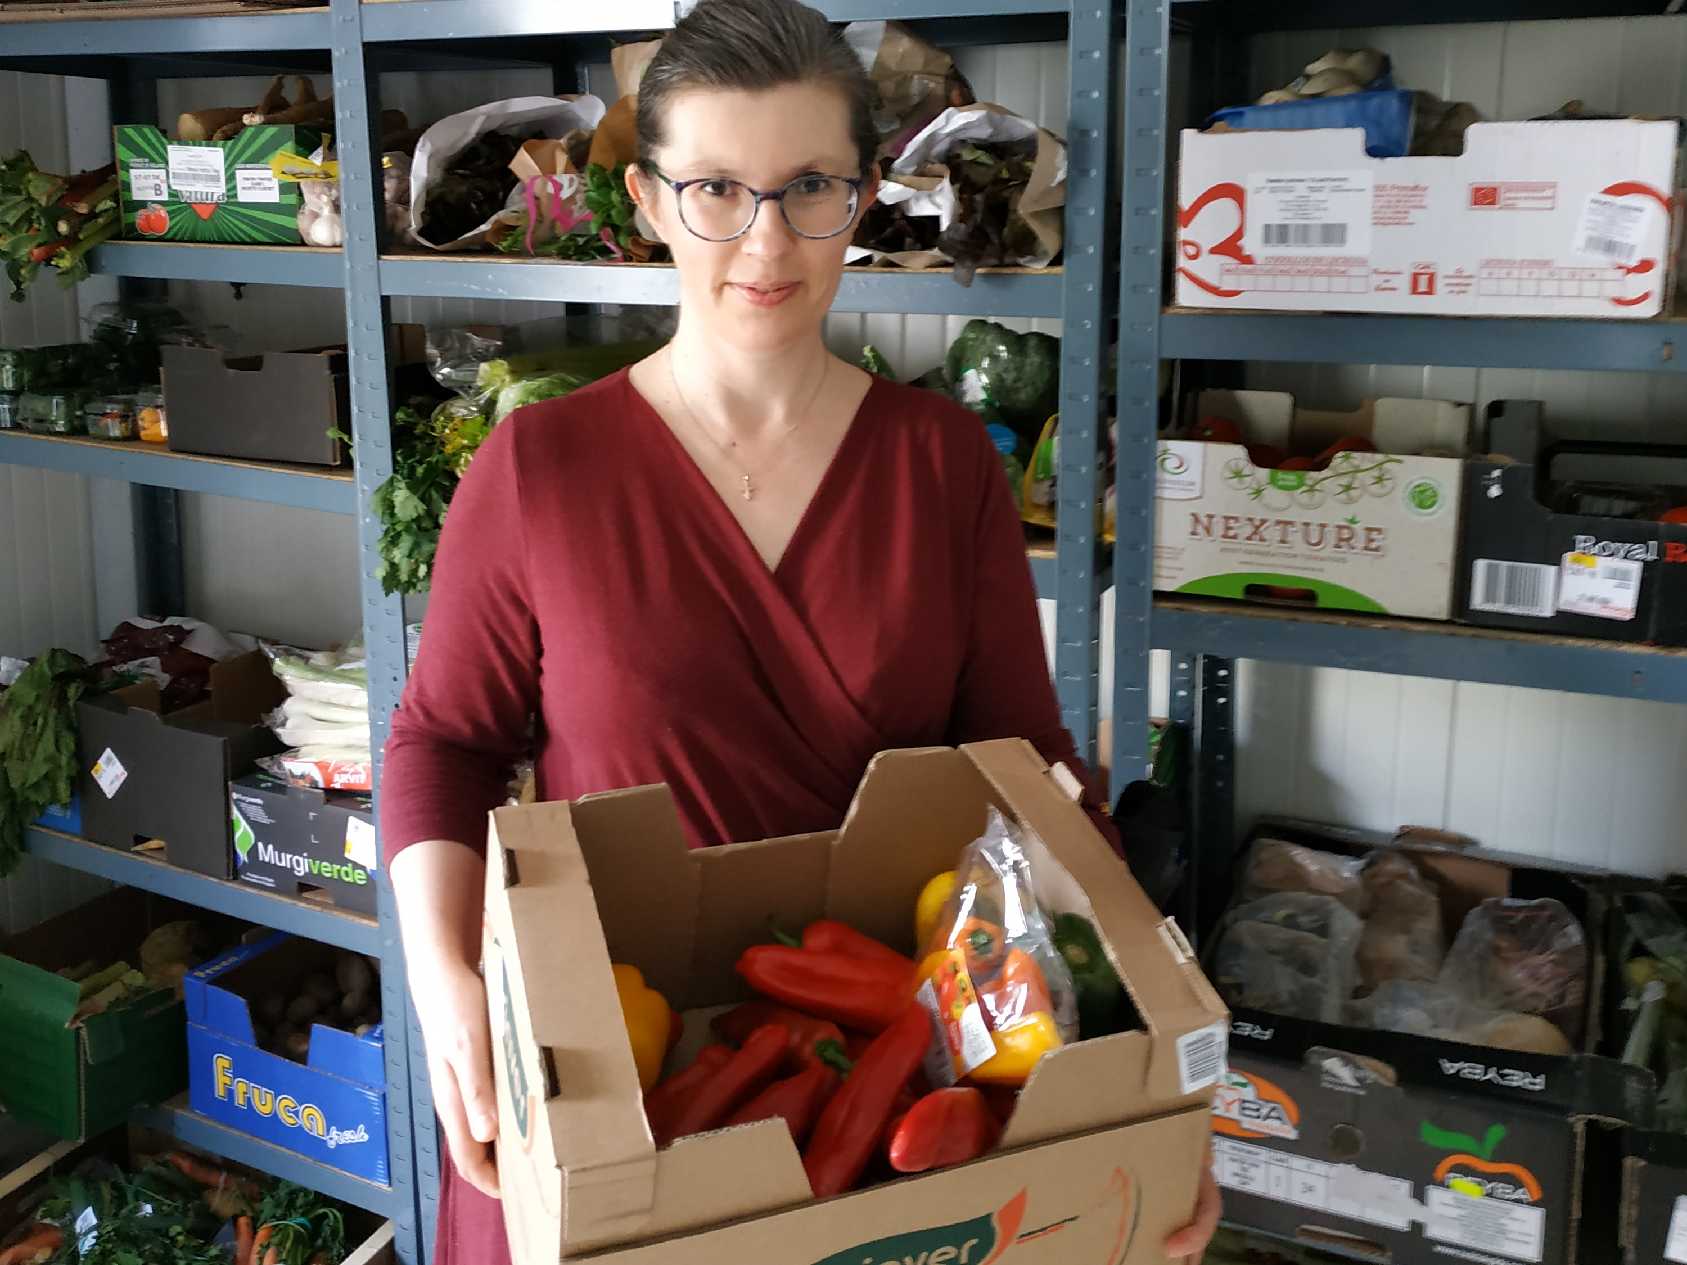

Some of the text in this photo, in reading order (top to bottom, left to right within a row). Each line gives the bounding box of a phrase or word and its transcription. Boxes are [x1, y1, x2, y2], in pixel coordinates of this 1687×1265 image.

[1189, 511, 1387, 553] NEXTURE
[257, 841, 369, 886] Murgiverde
[213, 1053, 327, 1141] Fruca
[326, 1124, 369, 1148] fresh
